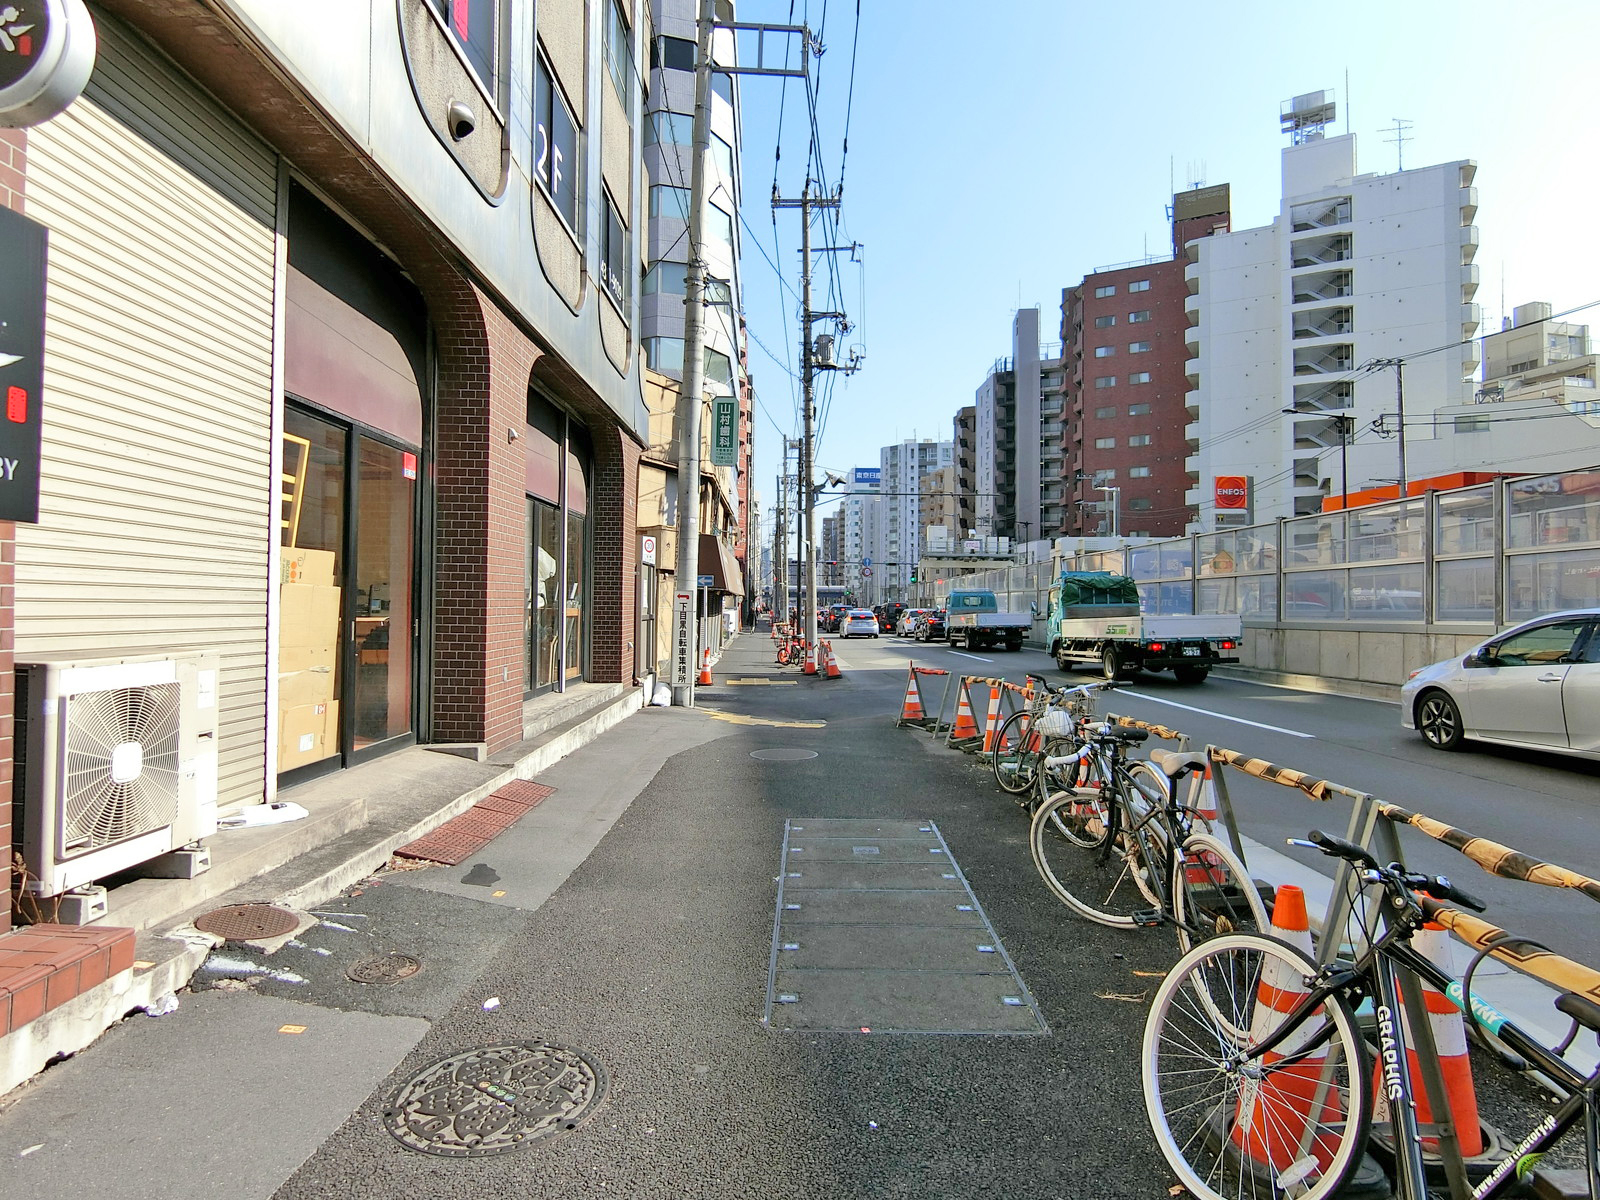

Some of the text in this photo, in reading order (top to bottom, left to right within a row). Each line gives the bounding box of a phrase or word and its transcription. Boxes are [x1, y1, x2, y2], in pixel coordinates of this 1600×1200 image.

[537, 123, 563, 194] 2F
[719, 403, 731, 448] 山村歯科
[1217, 488, 1245, 496] ENEOS
[678, 602, 688, 683] 下目黒自転車集積所
[1377, 1005, 1403, 1100] GRAPHIS
